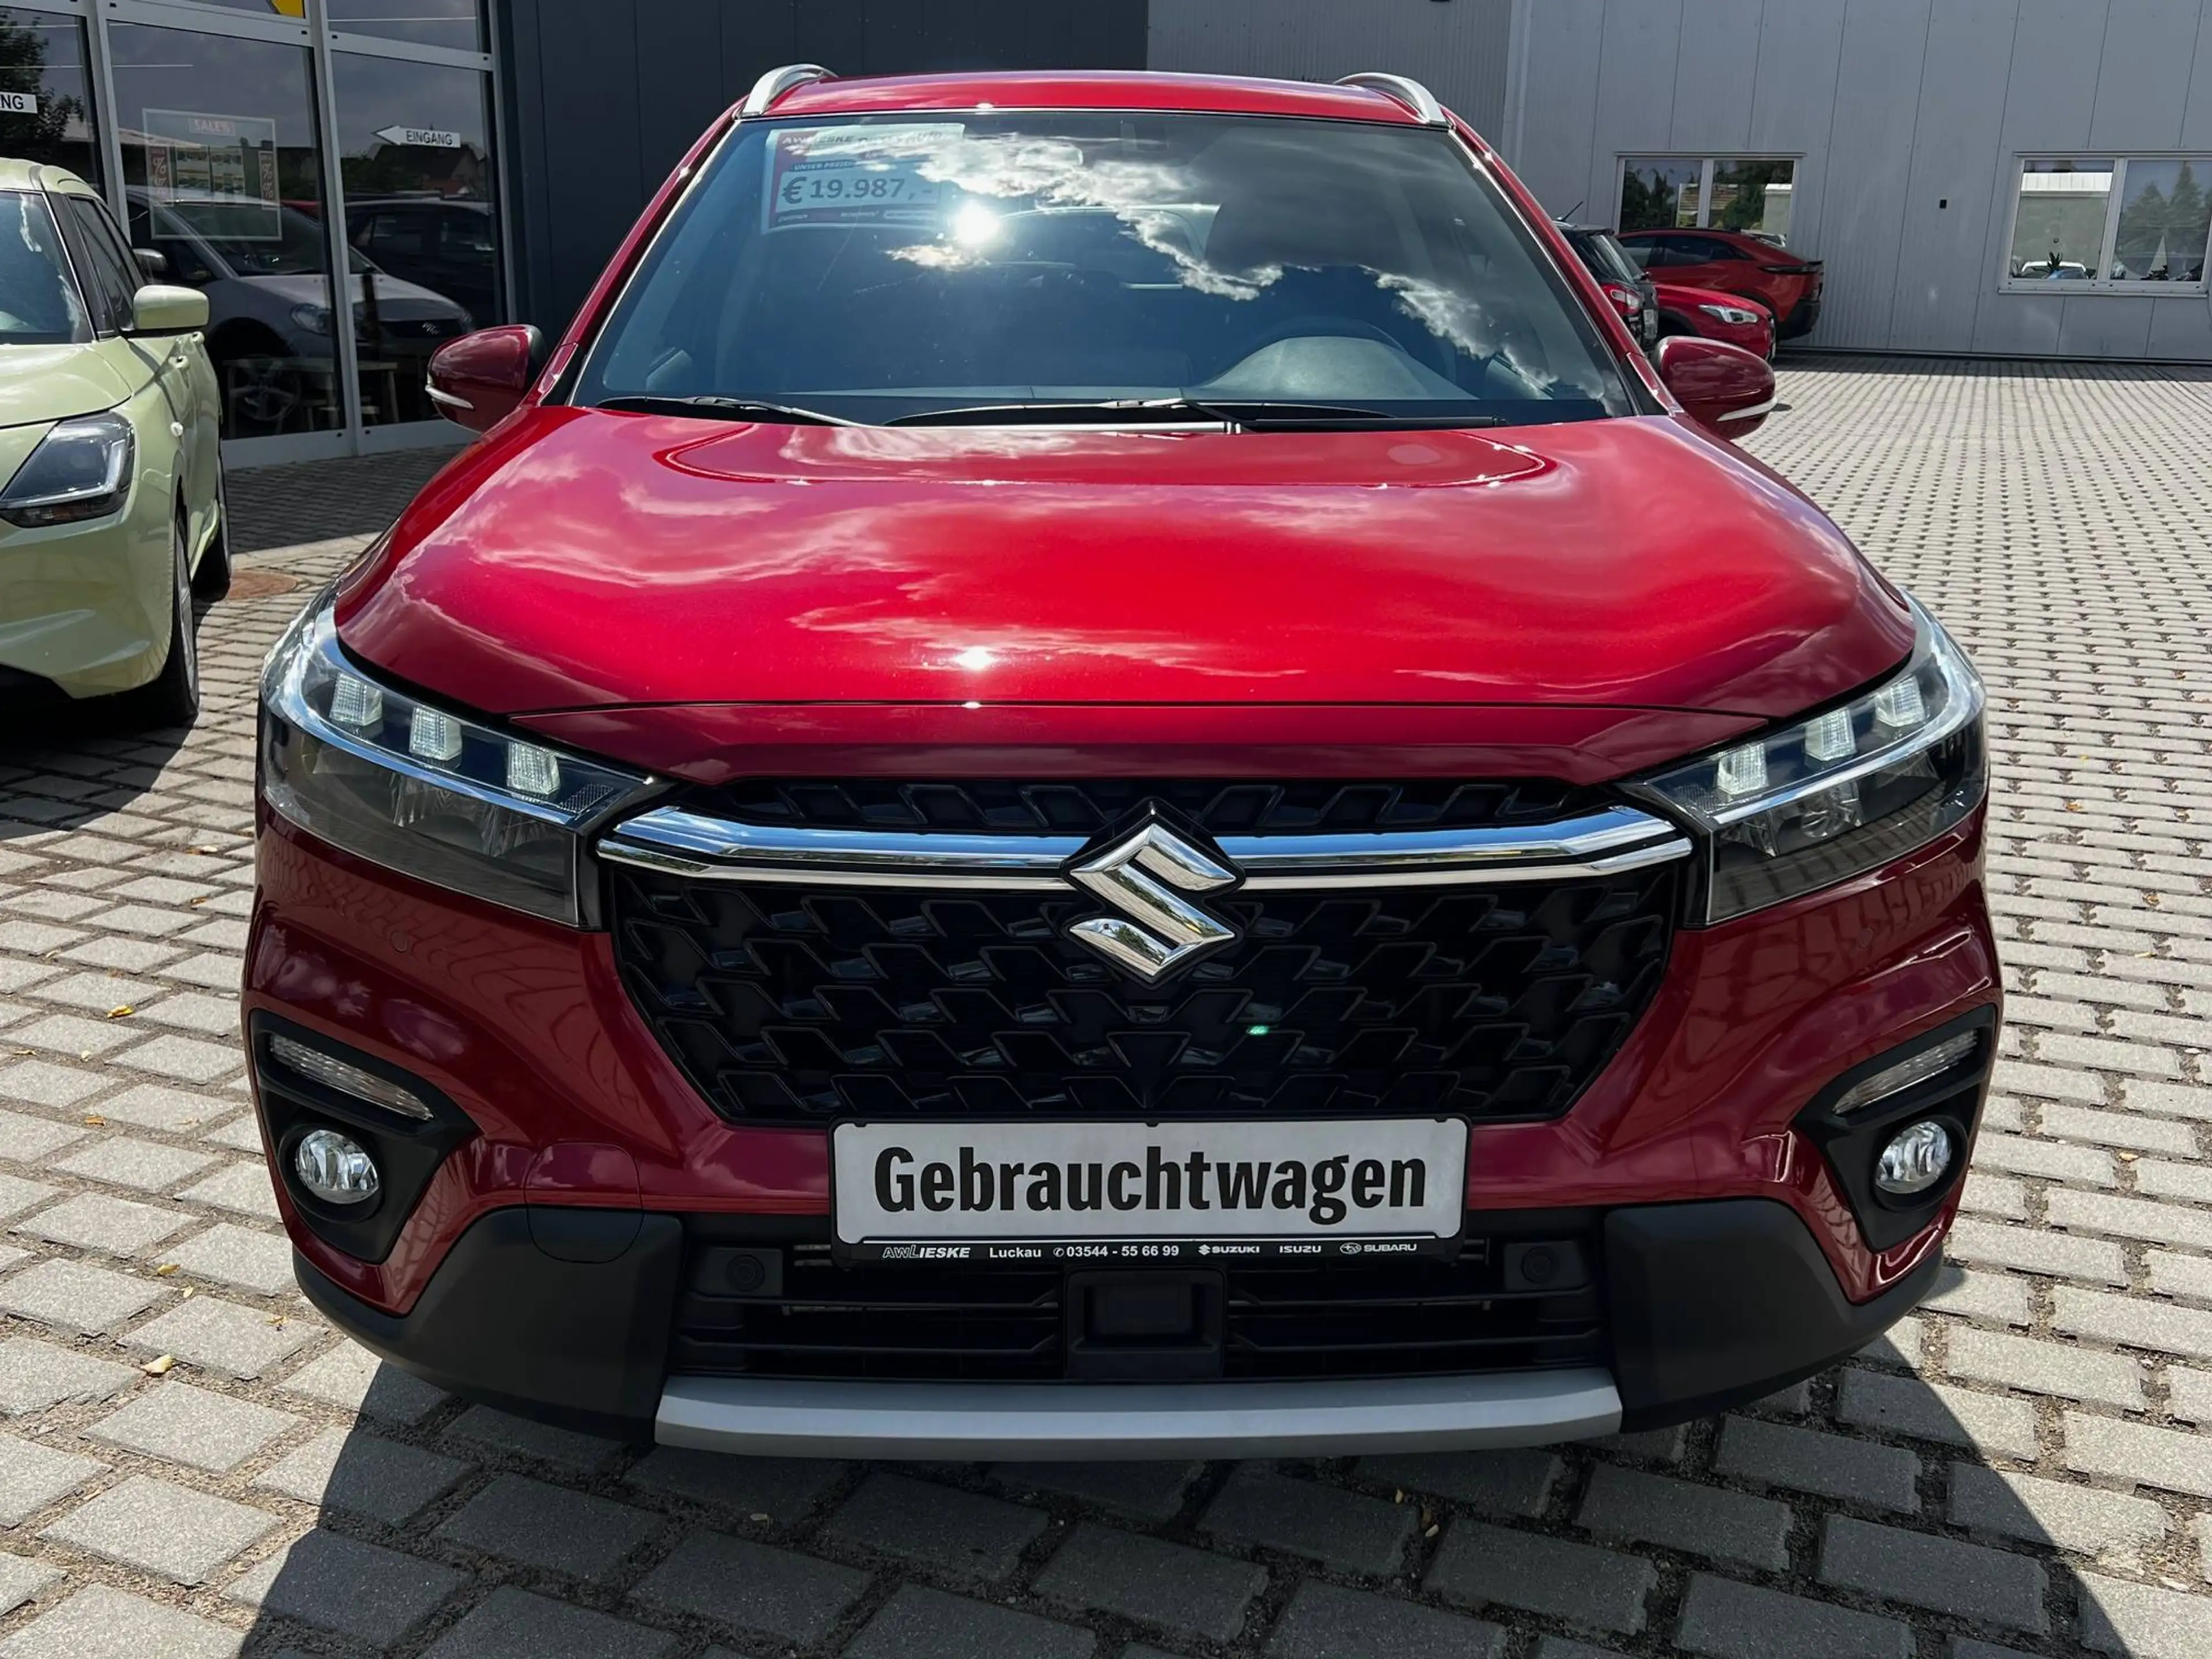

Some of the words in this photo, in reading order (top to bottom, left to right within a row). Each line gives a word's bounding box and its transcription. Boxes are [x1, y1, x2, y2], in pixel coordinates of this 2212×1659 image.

[406, 130, 453, 145] EINGANG
[874, 1146, 1426, 1225] Gebrauchtwagen
[990, 1247, 1041, 1257] Luckau
[1067, 1246, 1108, 1257] 03544
[1122, 1246, 1138, 1256] 55
[1142, 1246, 1159, 1256] 66
[1162, 1245, 1179, 1256] 99
[1279, 1245, 1321, 1253] ISUZU
[1363, 1244, 1418, 1252] SUBARU
